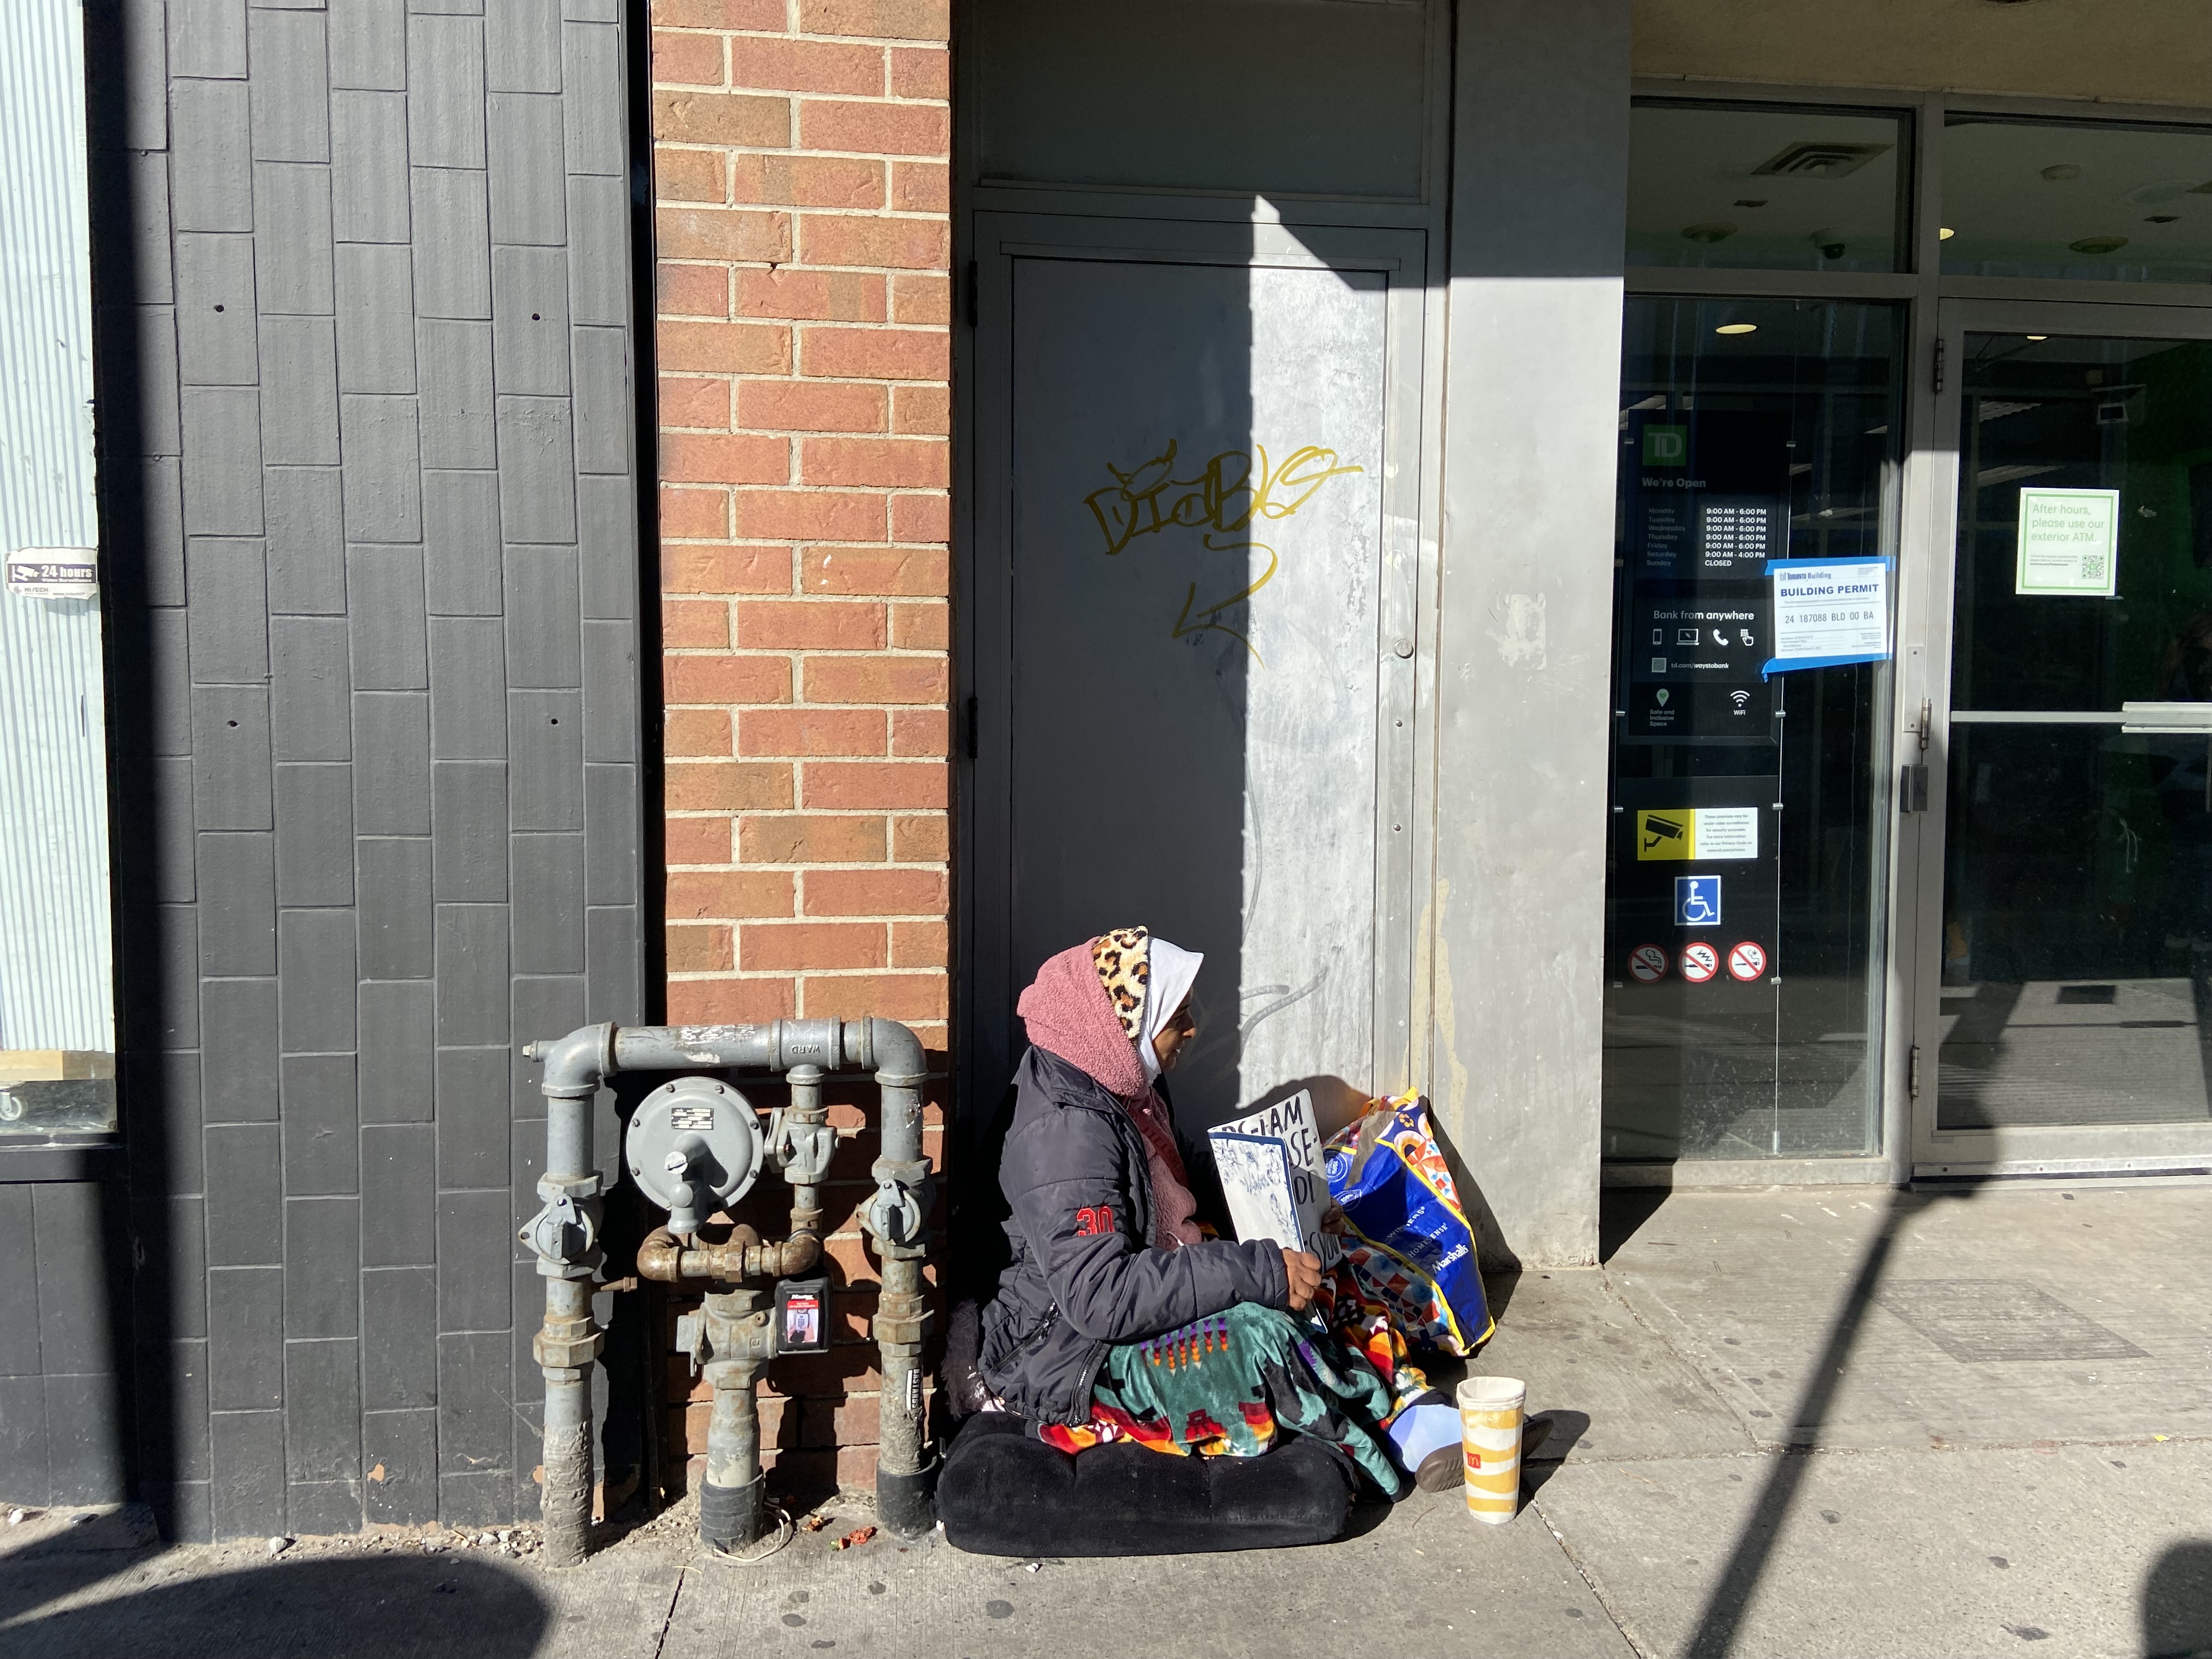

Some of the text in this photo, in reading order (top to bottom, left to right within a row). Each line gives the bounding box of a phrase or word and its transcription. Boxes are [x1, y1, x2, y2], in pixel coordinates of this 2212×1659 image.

[1648, 432, 1682, 458] TD
[1642, 477, 1706, 489] We're Open
[2032, 504, 2091, 515] After hours,
[2032, 518, 2065, 529] please
[2031, 533, 2097, 542] exterior ATM.
[41, 565, 92, 578] 24 hours
[1808, 572, 1831, 580] Building
[1781, 584, 1880, 597] BUILDING PERMIT
[1654, 610, 1754, 622] Bank from anywhere
[1785, 615, 1794, 624] 24
[1799, 613, 1827, 623] 187088
[1831, 612, 1846, 621] BLD
[1864, 611, 1874, 619] BA
[791, 1045, 820, 1054] WARD
[1432, 1243, 1469, 1274] Marshalls
[911, 1369, 921, 1408] BASTARDS
